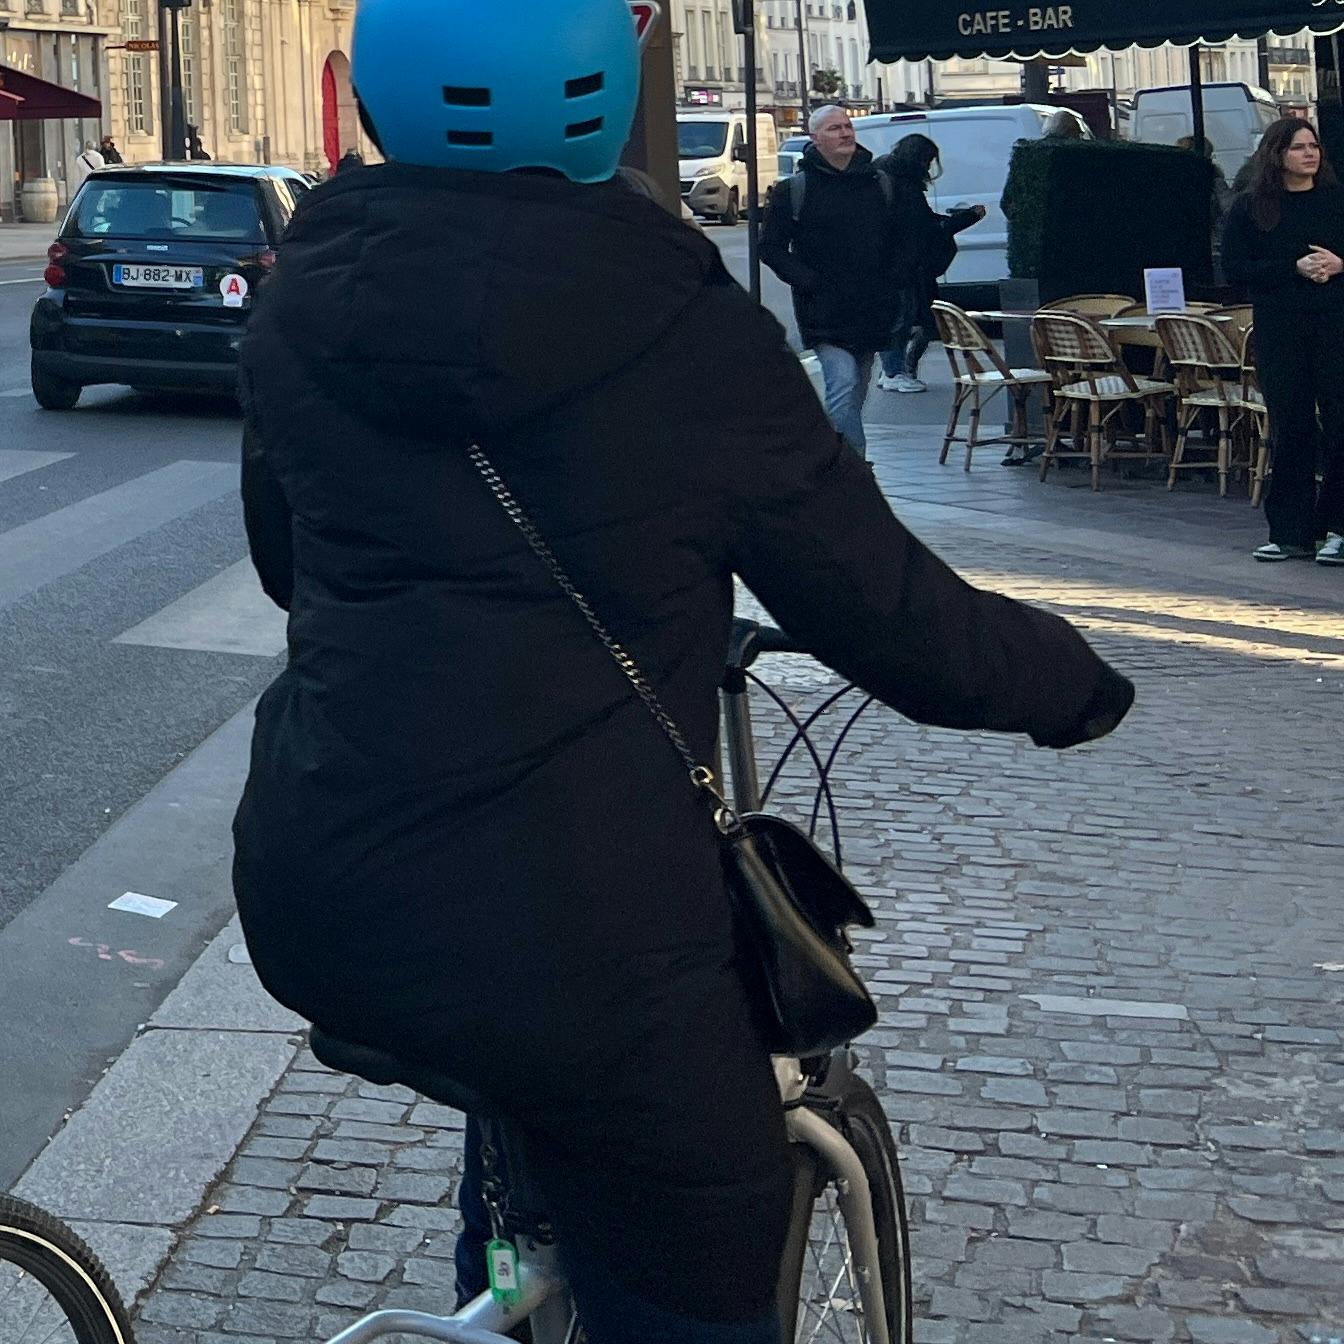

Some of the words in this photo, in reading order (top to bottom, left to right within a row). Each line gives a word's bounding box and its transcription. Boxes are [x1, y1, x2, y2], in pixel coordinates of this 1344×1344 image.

[958, 10, 1012, 36] CAFE
[1028, 5, 1074, 31] BAR
[227, 277, 241, 295] A
